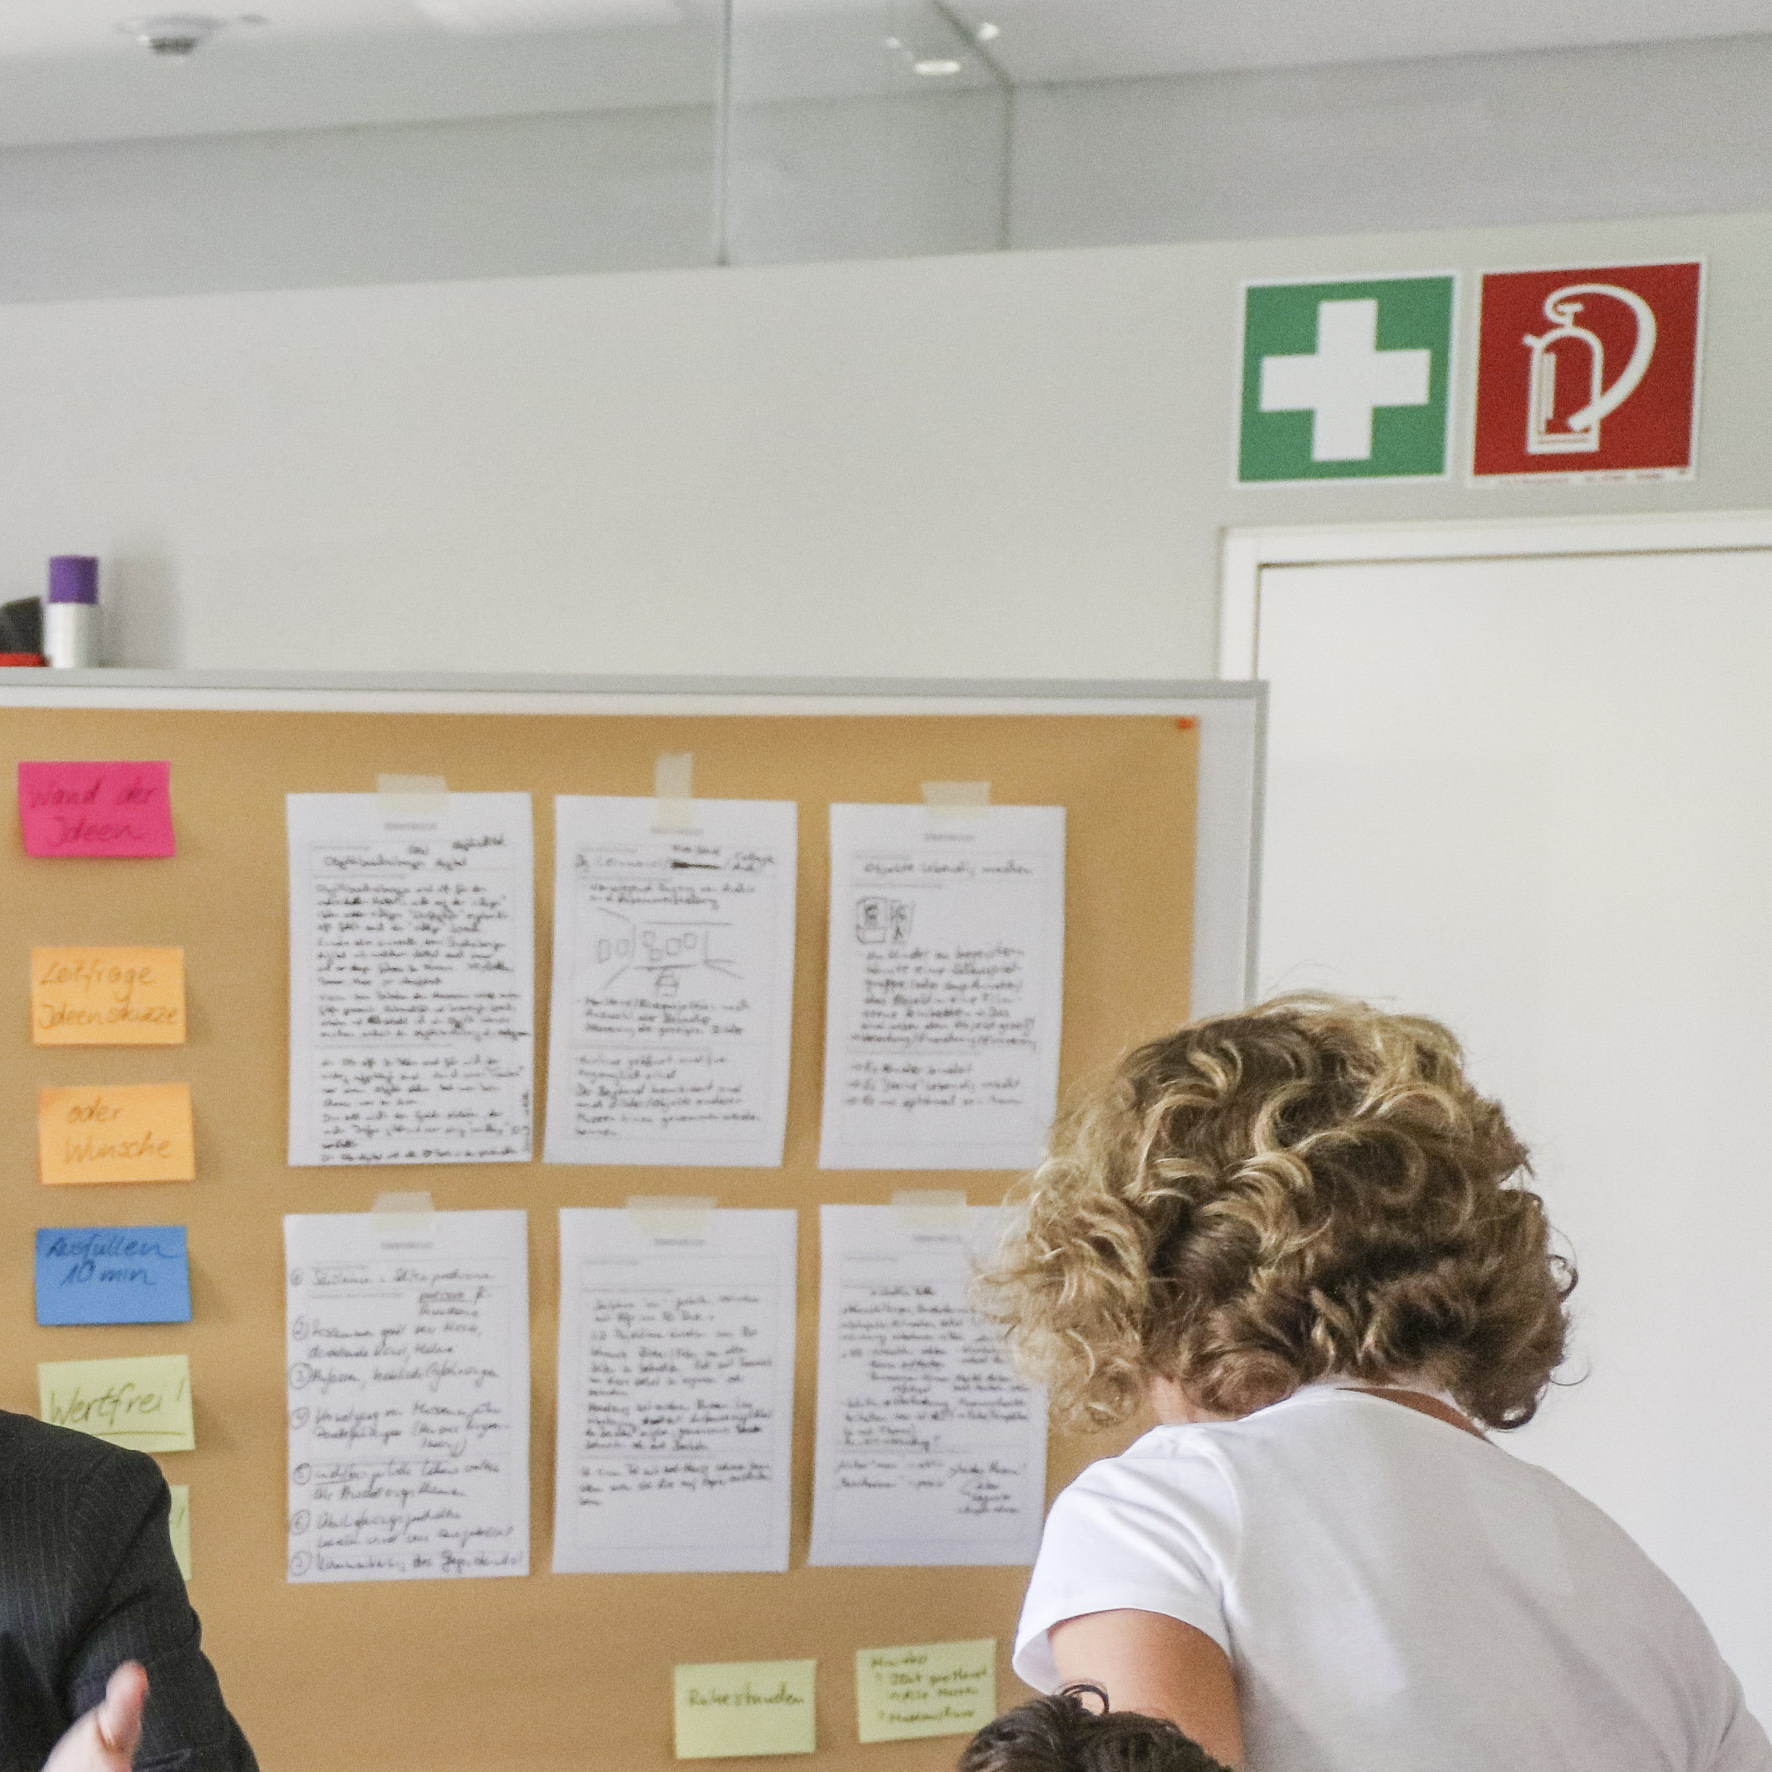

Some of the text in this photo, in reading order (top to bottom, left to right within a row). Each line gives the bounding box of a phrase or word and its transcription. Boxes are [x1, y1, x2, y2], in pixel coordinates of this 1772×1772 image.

[67, 1095, 123, 1124] oder
[60, 1257, 157, 1289] 10 min
